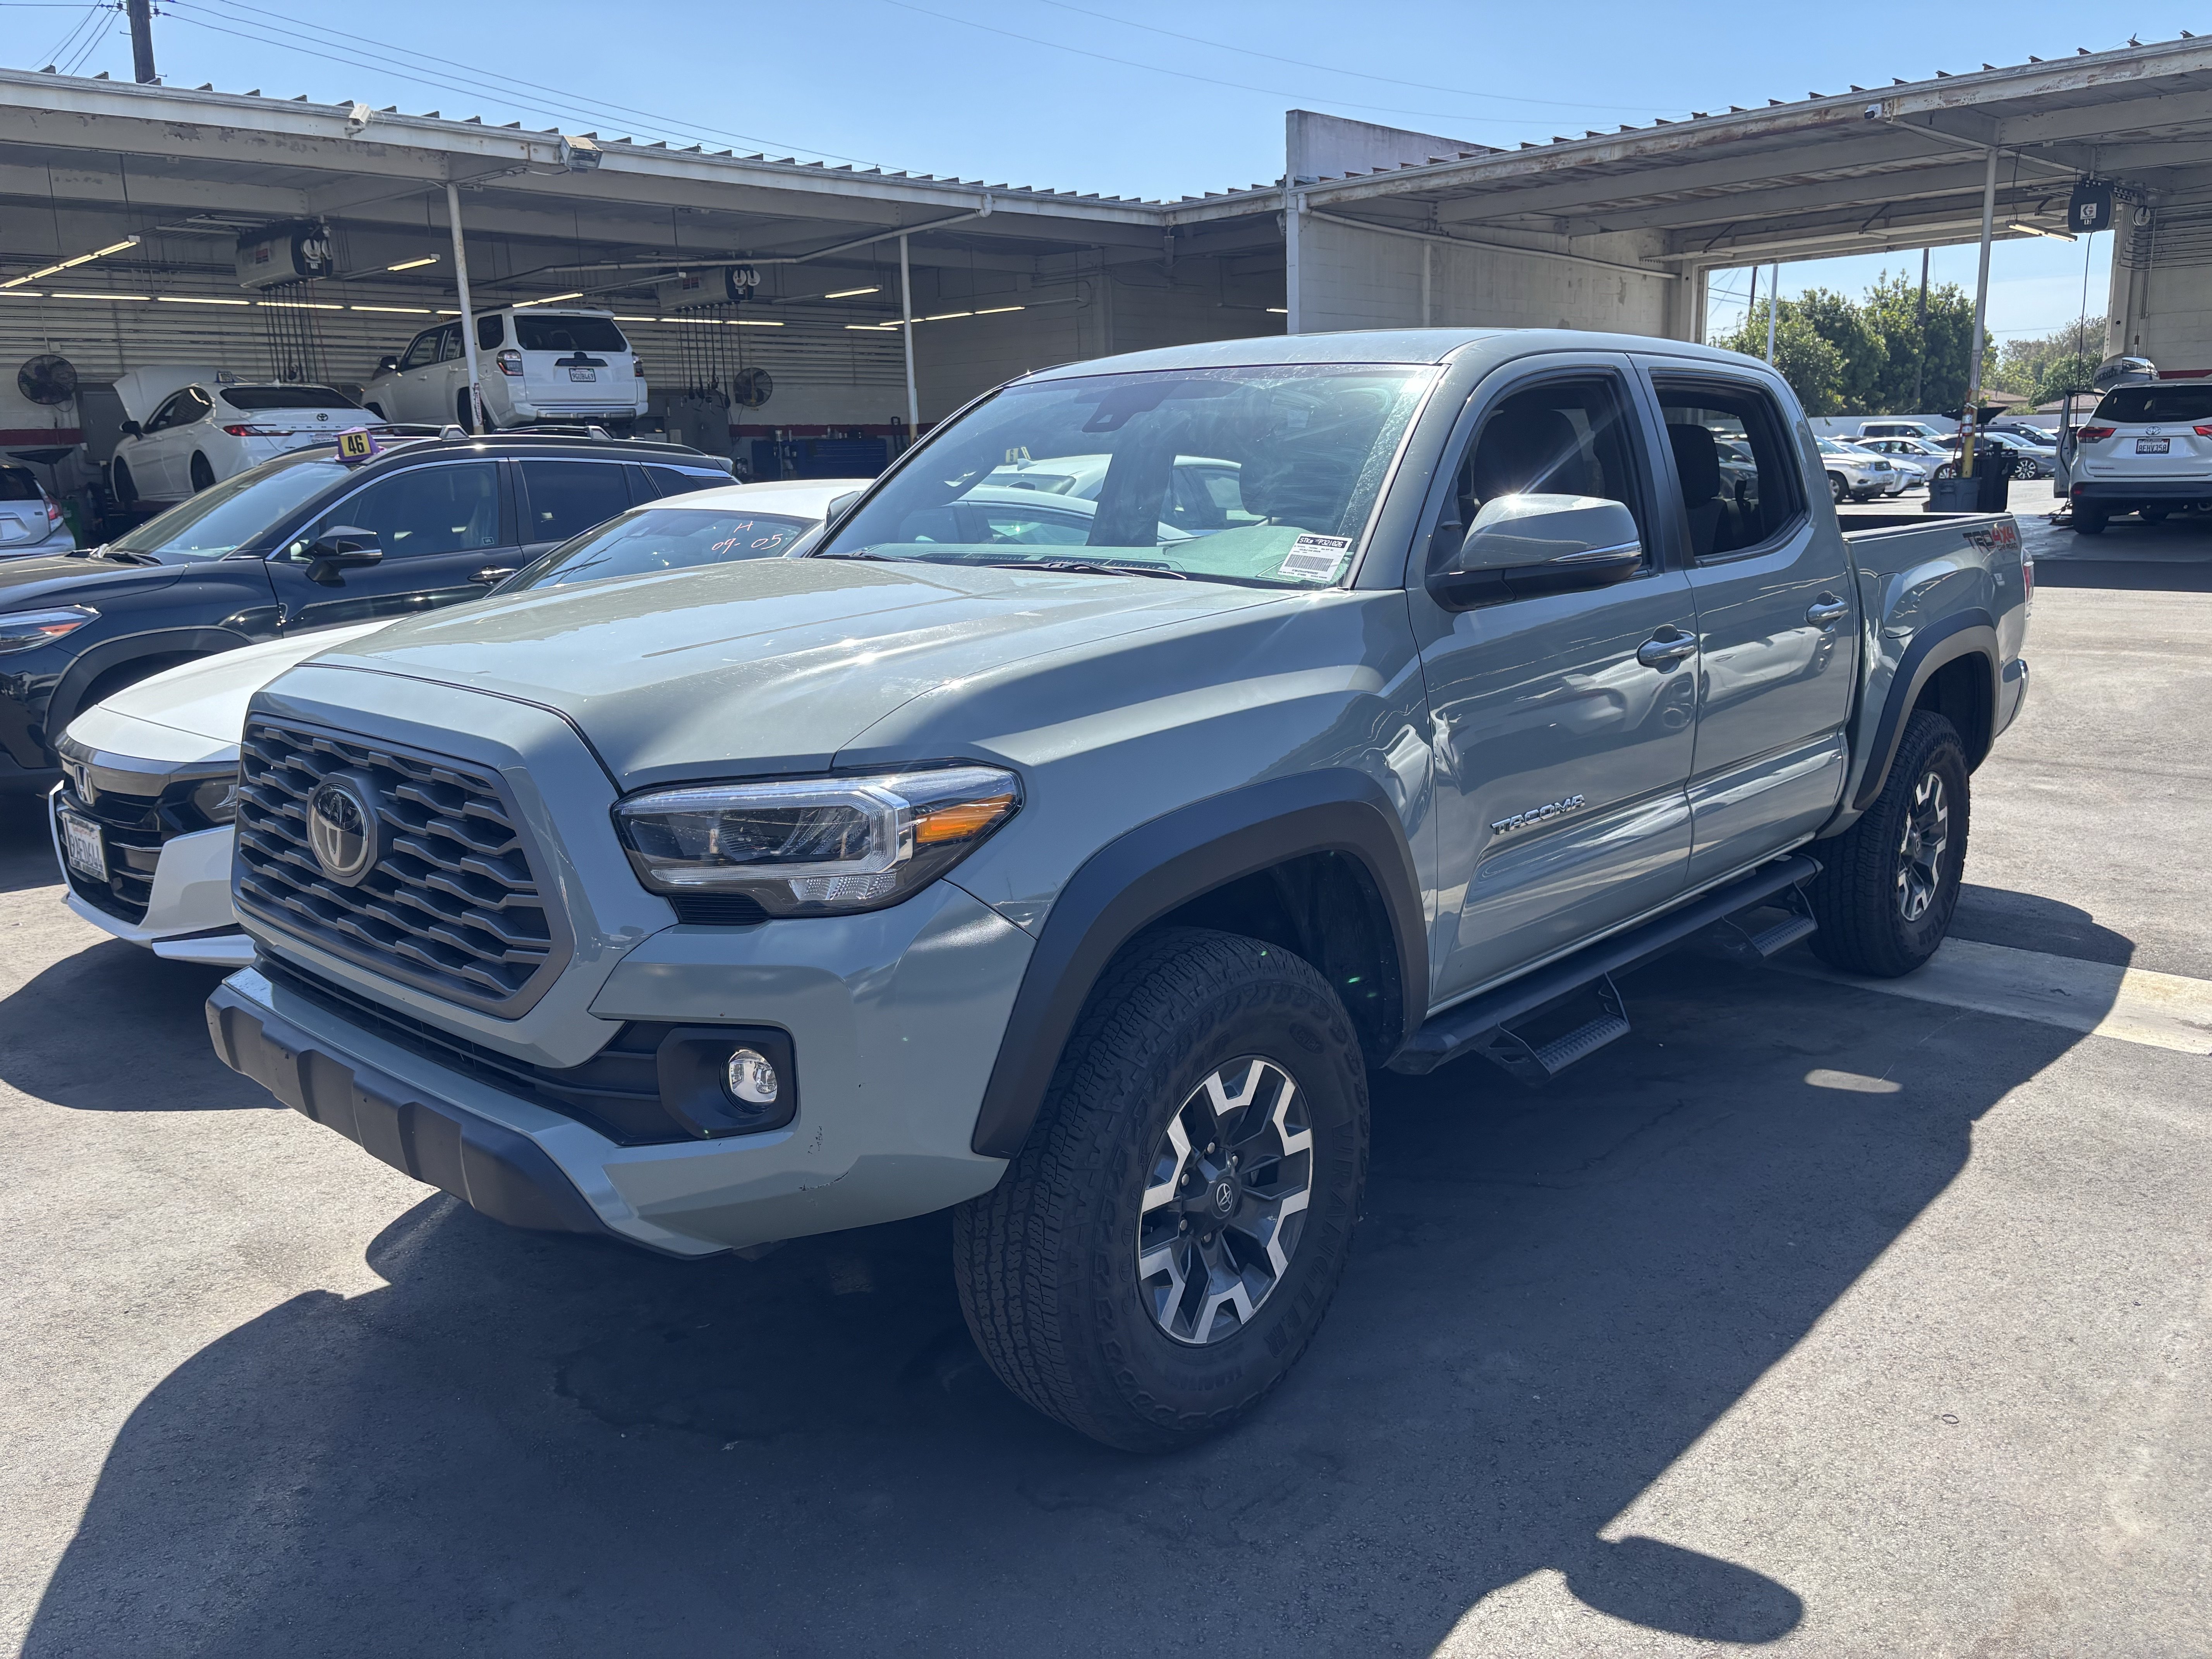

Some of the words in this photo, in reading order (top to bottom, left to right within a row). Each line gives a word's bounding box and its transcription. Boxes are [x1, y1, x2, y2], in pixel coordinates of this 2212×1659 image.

[348, 435, 365, 453] 46
[1962, 529, 1996, 553] TRD
[1491, 794, 1585, 835] TACOMA
